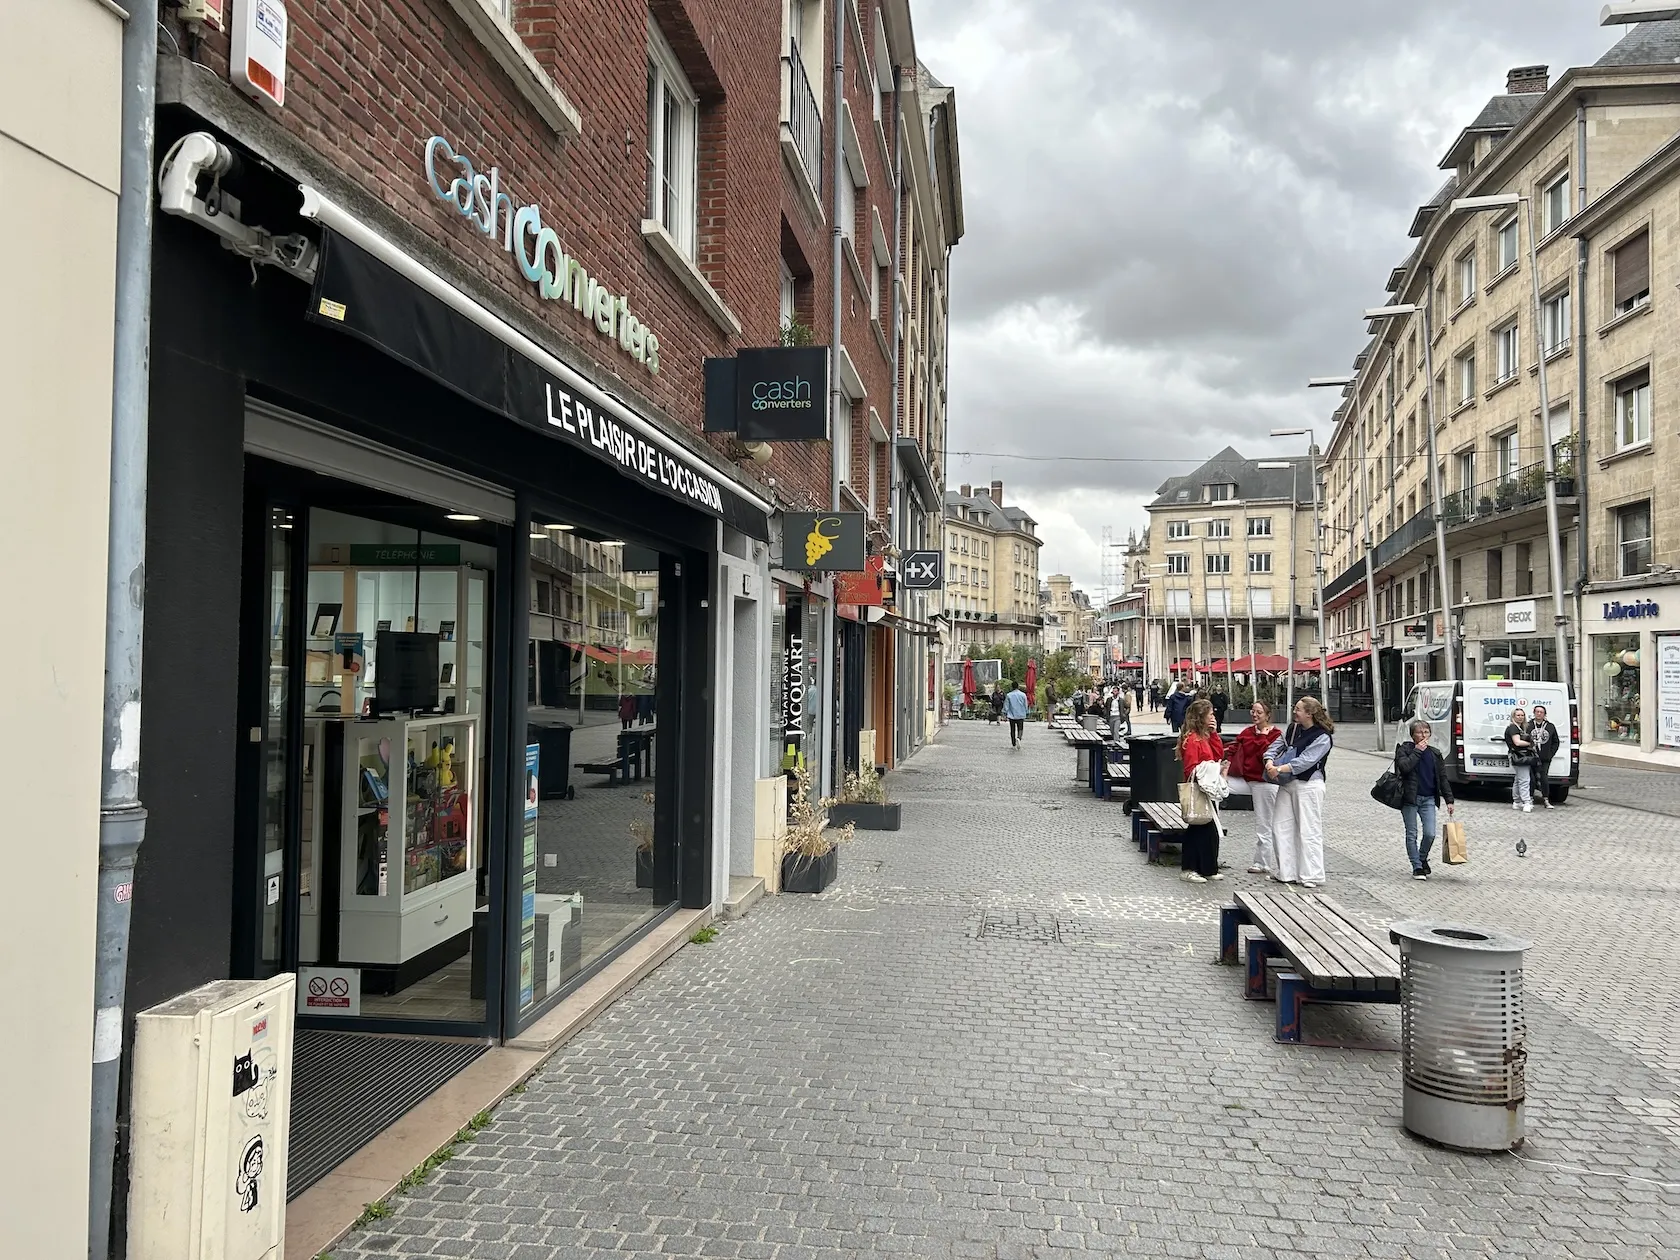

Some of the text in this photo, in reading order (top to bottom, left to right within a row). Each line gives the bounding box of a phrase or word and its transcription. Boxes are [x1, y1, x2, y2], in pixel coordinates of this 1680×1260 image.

[752, 375, 811, 410] cash converters
[545, 383, 724, 513] LE PLAISIR DE L'OCCASION
[1507, 611, 1532, 623] GEOX
[1603, 599, 1659, 620] Librairie
[785, 634, 807, 740] JACQUART
[1483, 697, 1516, 706] SUPER
